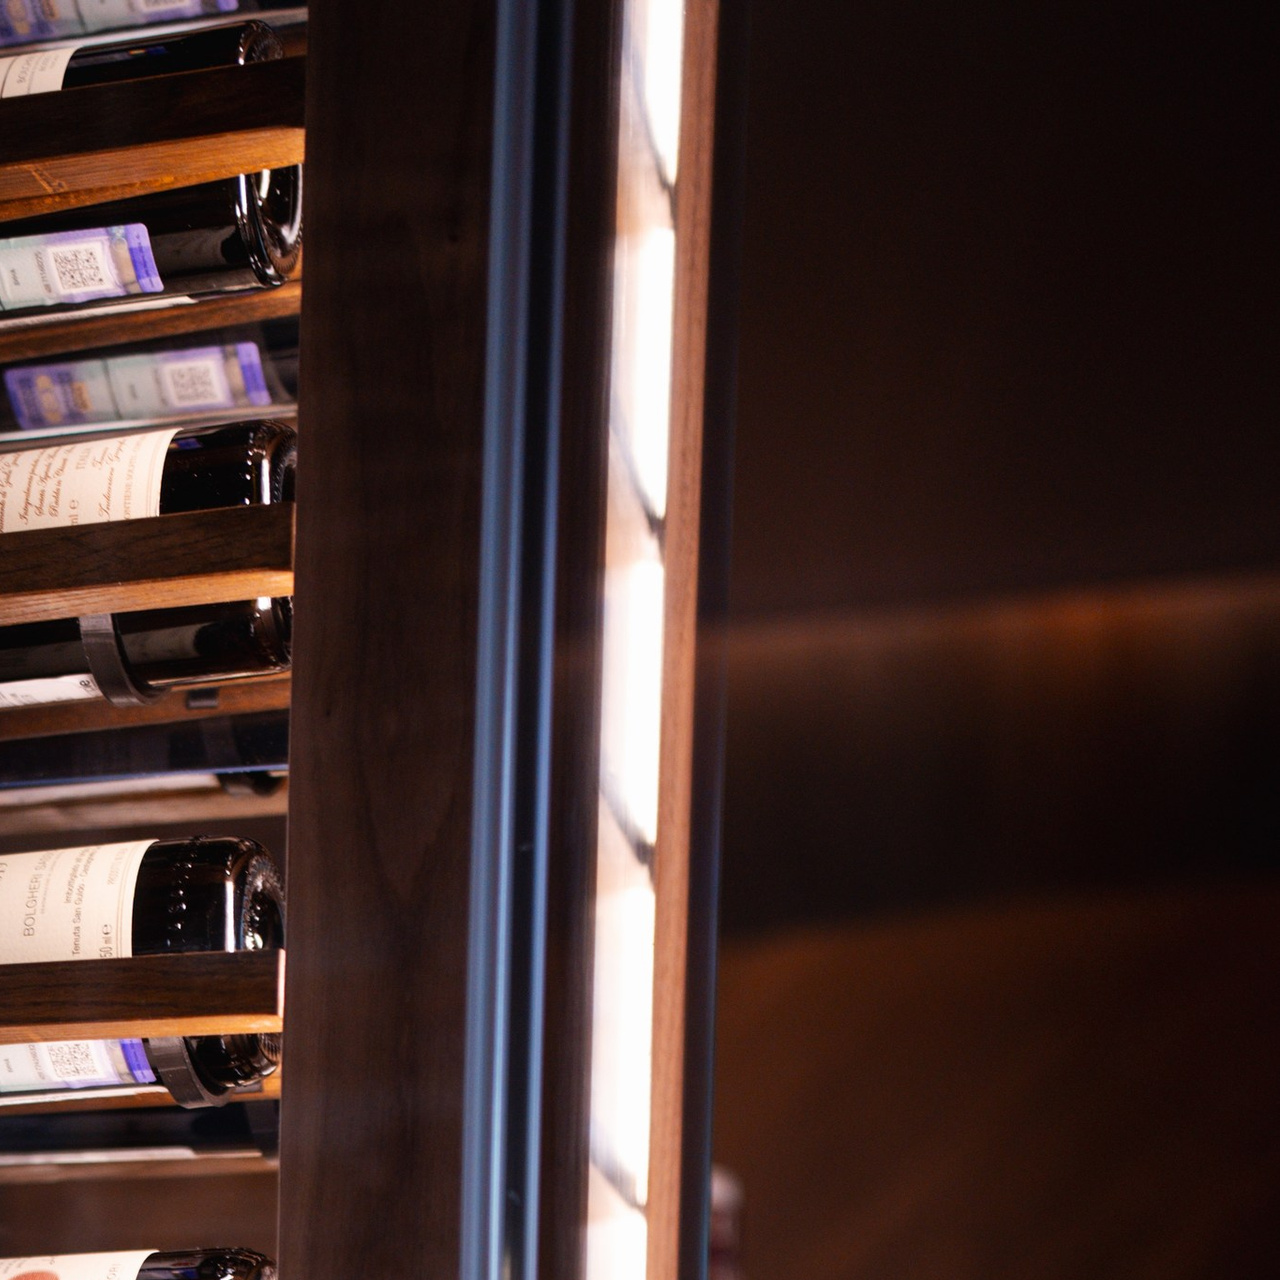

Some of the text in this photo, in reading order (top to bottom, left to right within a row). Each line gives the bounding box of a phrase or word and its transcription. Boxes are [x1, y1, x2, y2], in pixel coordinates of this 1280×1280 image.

[23, 873, 43, 937] BOLGHERI
[71, 926, 81, 956] Tenuta
[99, 946, 113, 958] 50
